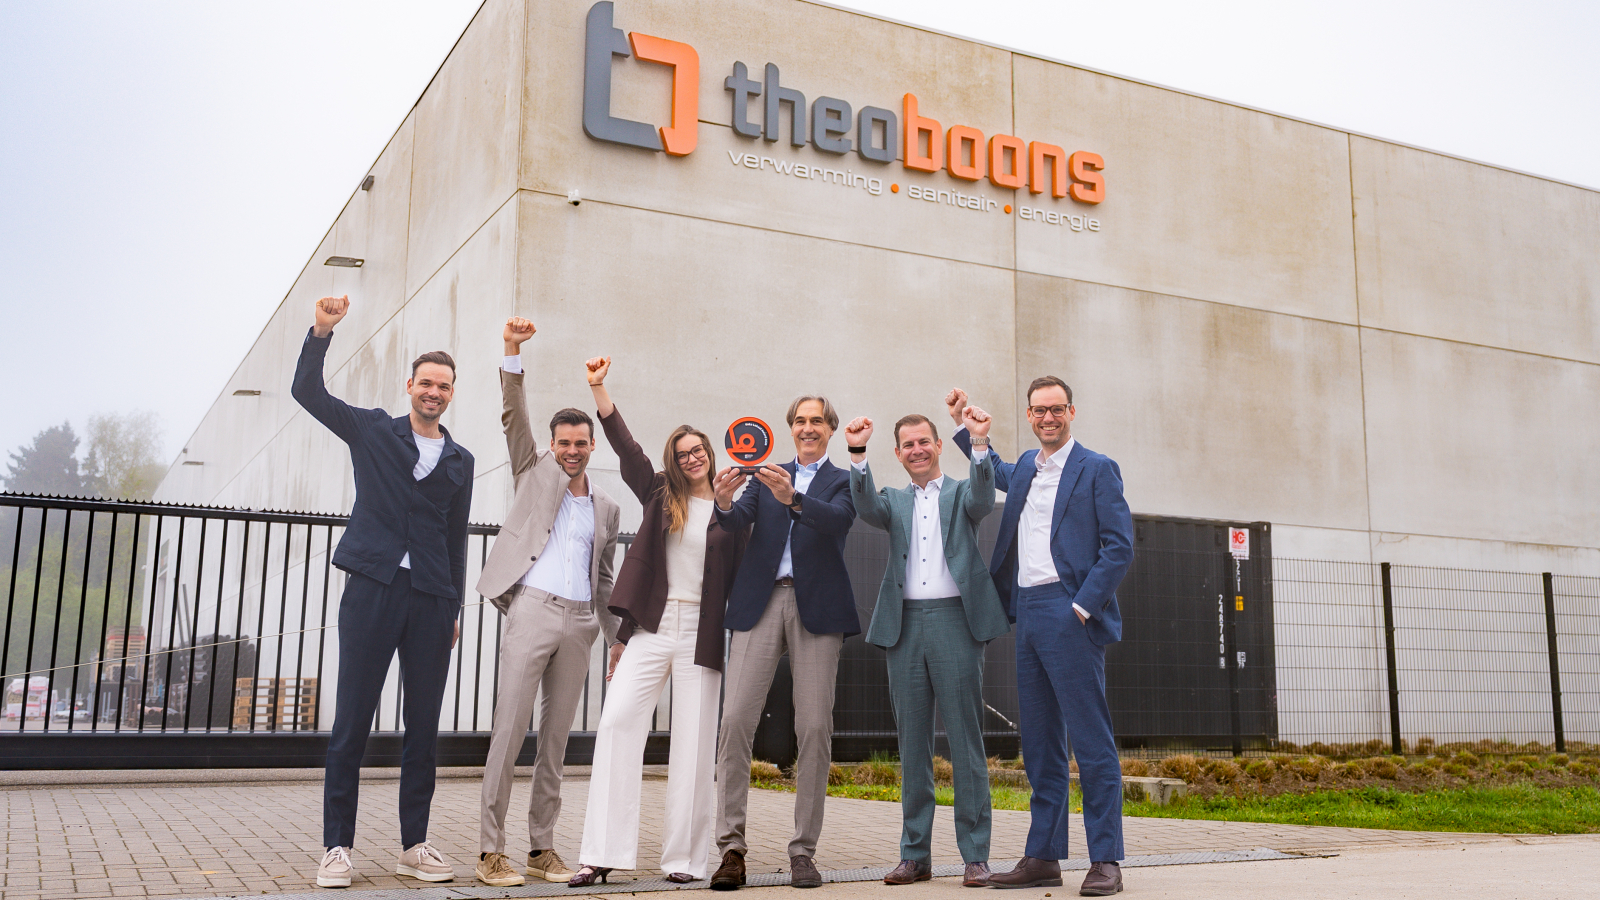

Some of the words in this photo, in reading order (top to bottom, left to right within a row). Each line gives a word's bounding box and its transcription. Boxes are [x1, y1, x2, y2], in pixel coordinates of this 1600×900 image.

[728, 149, 883, 196] verwarming
[908, 182, 998, 212] sanitair
[1019, 204, 1101, 232] energie
